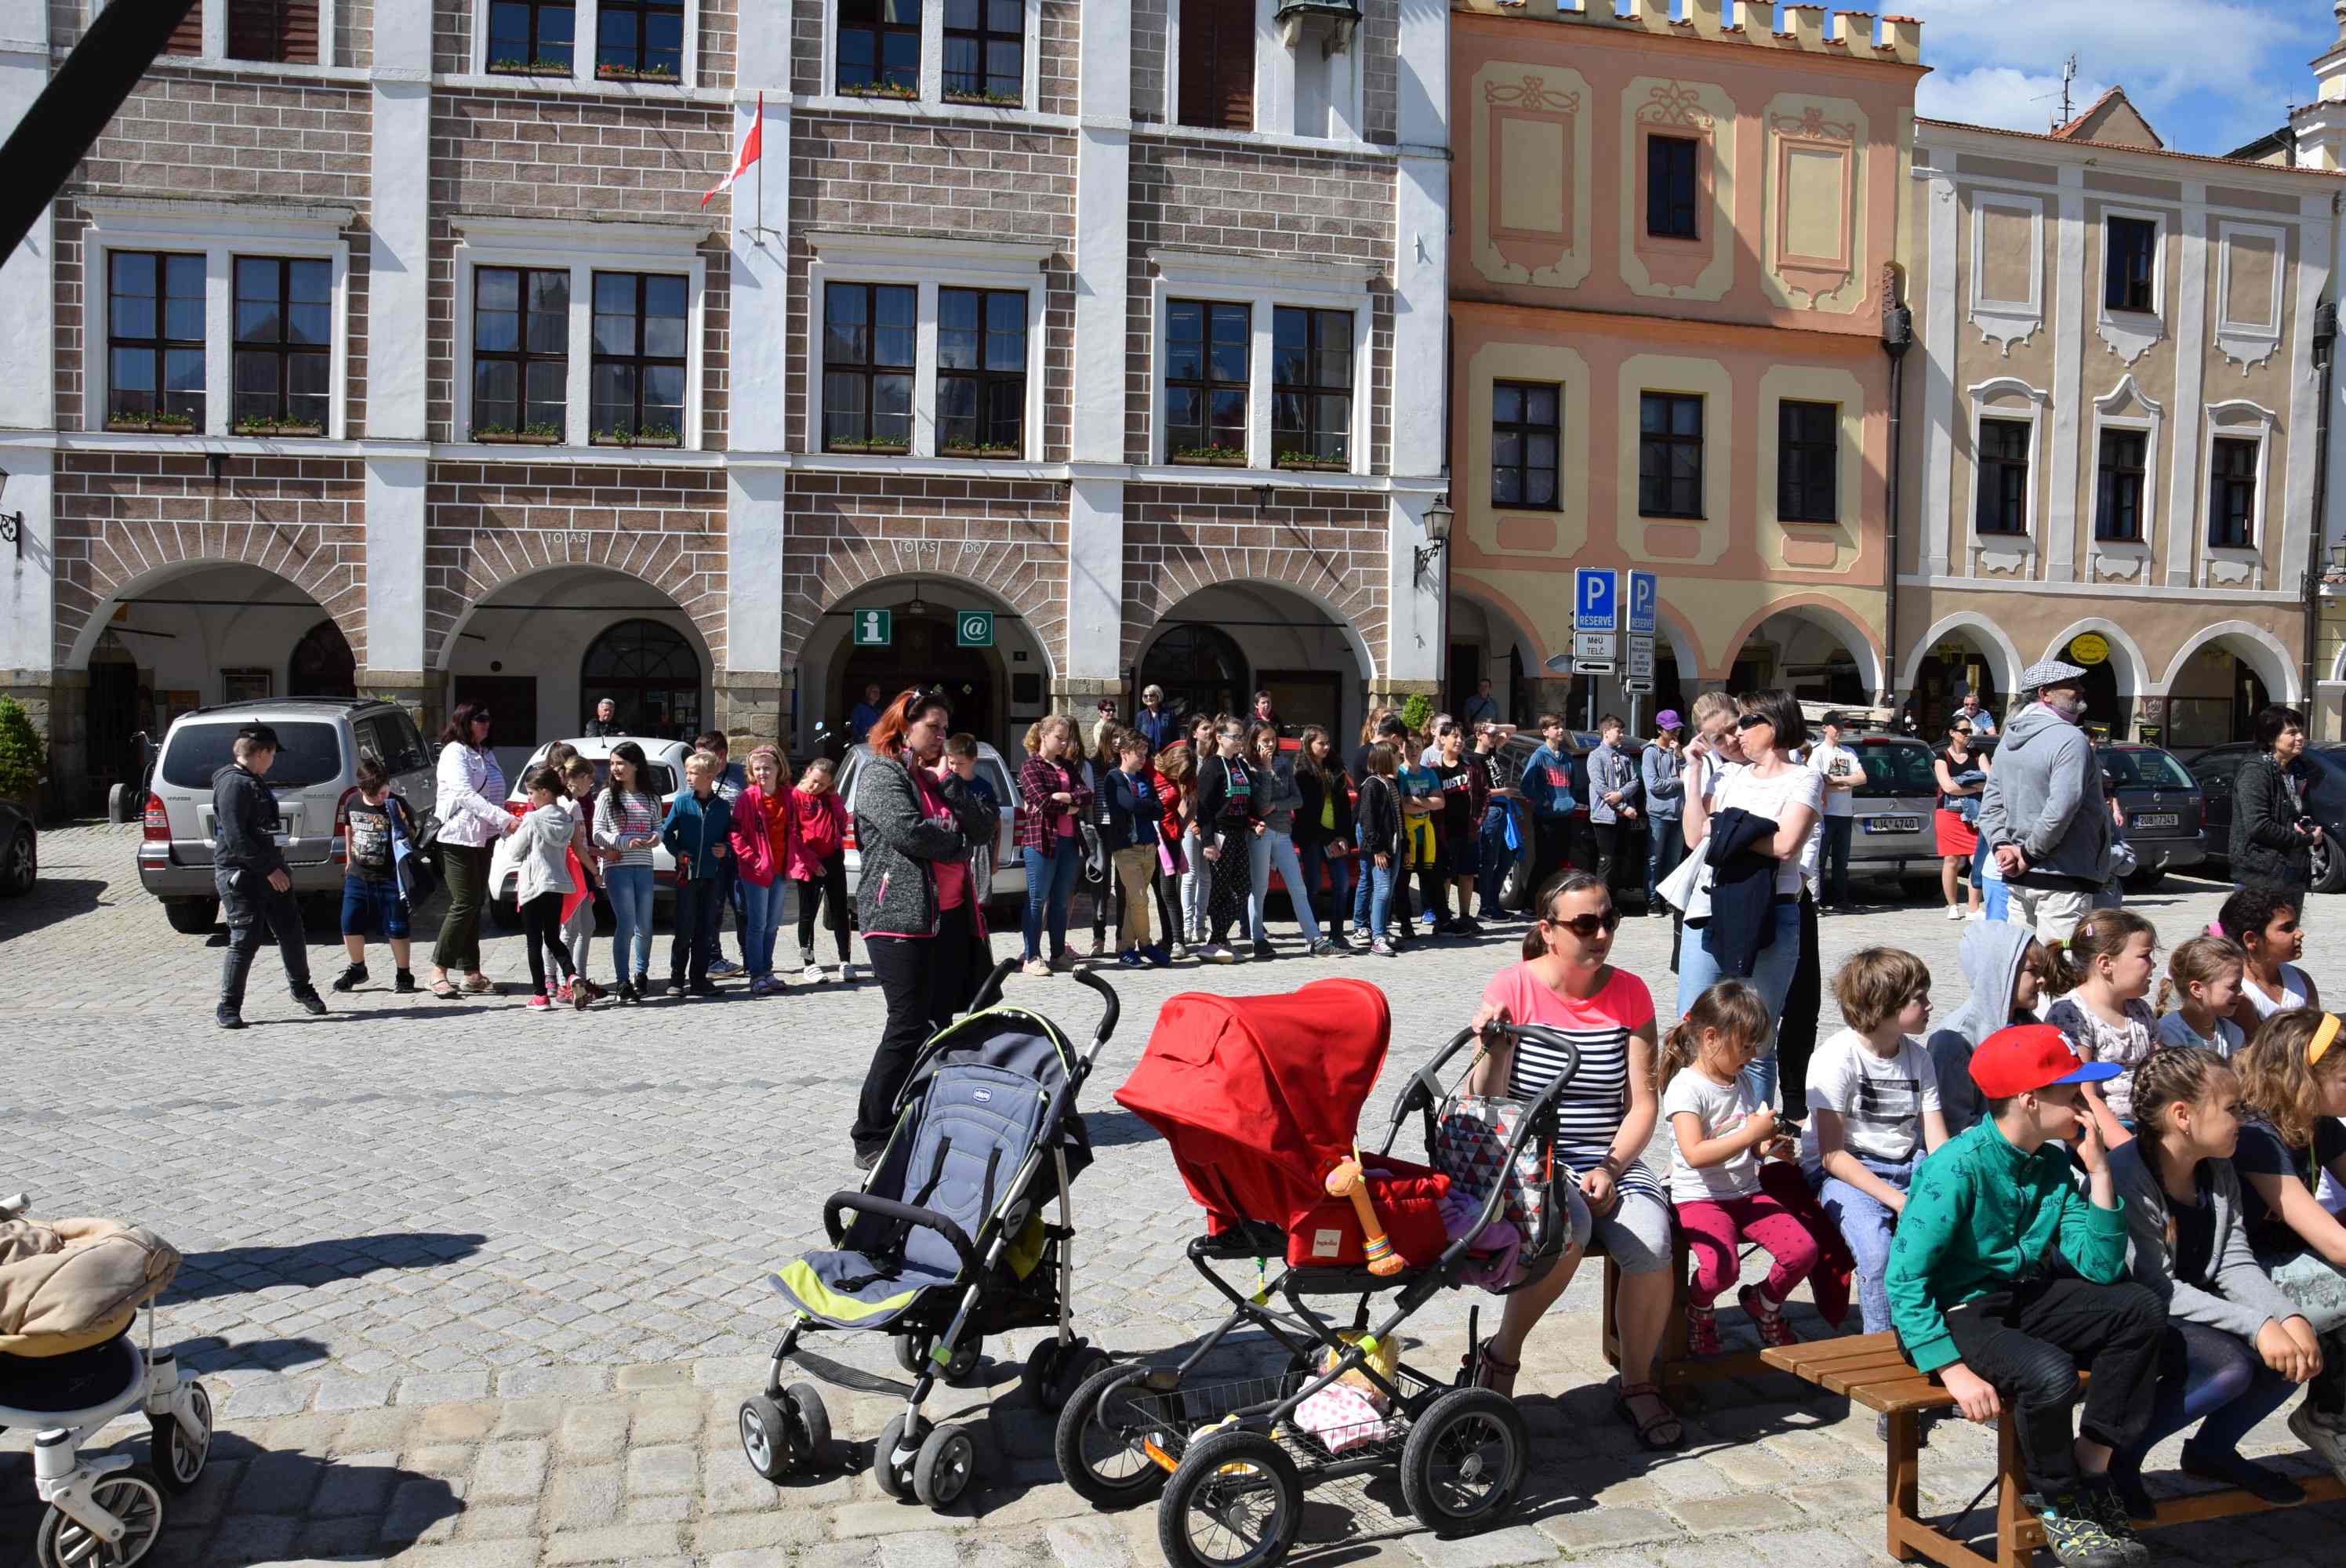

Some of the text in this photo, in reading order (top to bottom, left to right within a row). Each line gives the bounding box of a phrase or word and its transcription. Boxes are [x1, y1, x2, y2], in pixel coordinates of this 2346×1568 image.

[1587, 576, 1606, 609] P
[1636, 579, 1650, 612] P
[1579, 613, 1613, 626] RÉSERVÉ
[1587, 646, 1605, 655] TELČ
[1443, 775, 1462, 791] JUST
[1894, 818, 1915, 829] 4740
